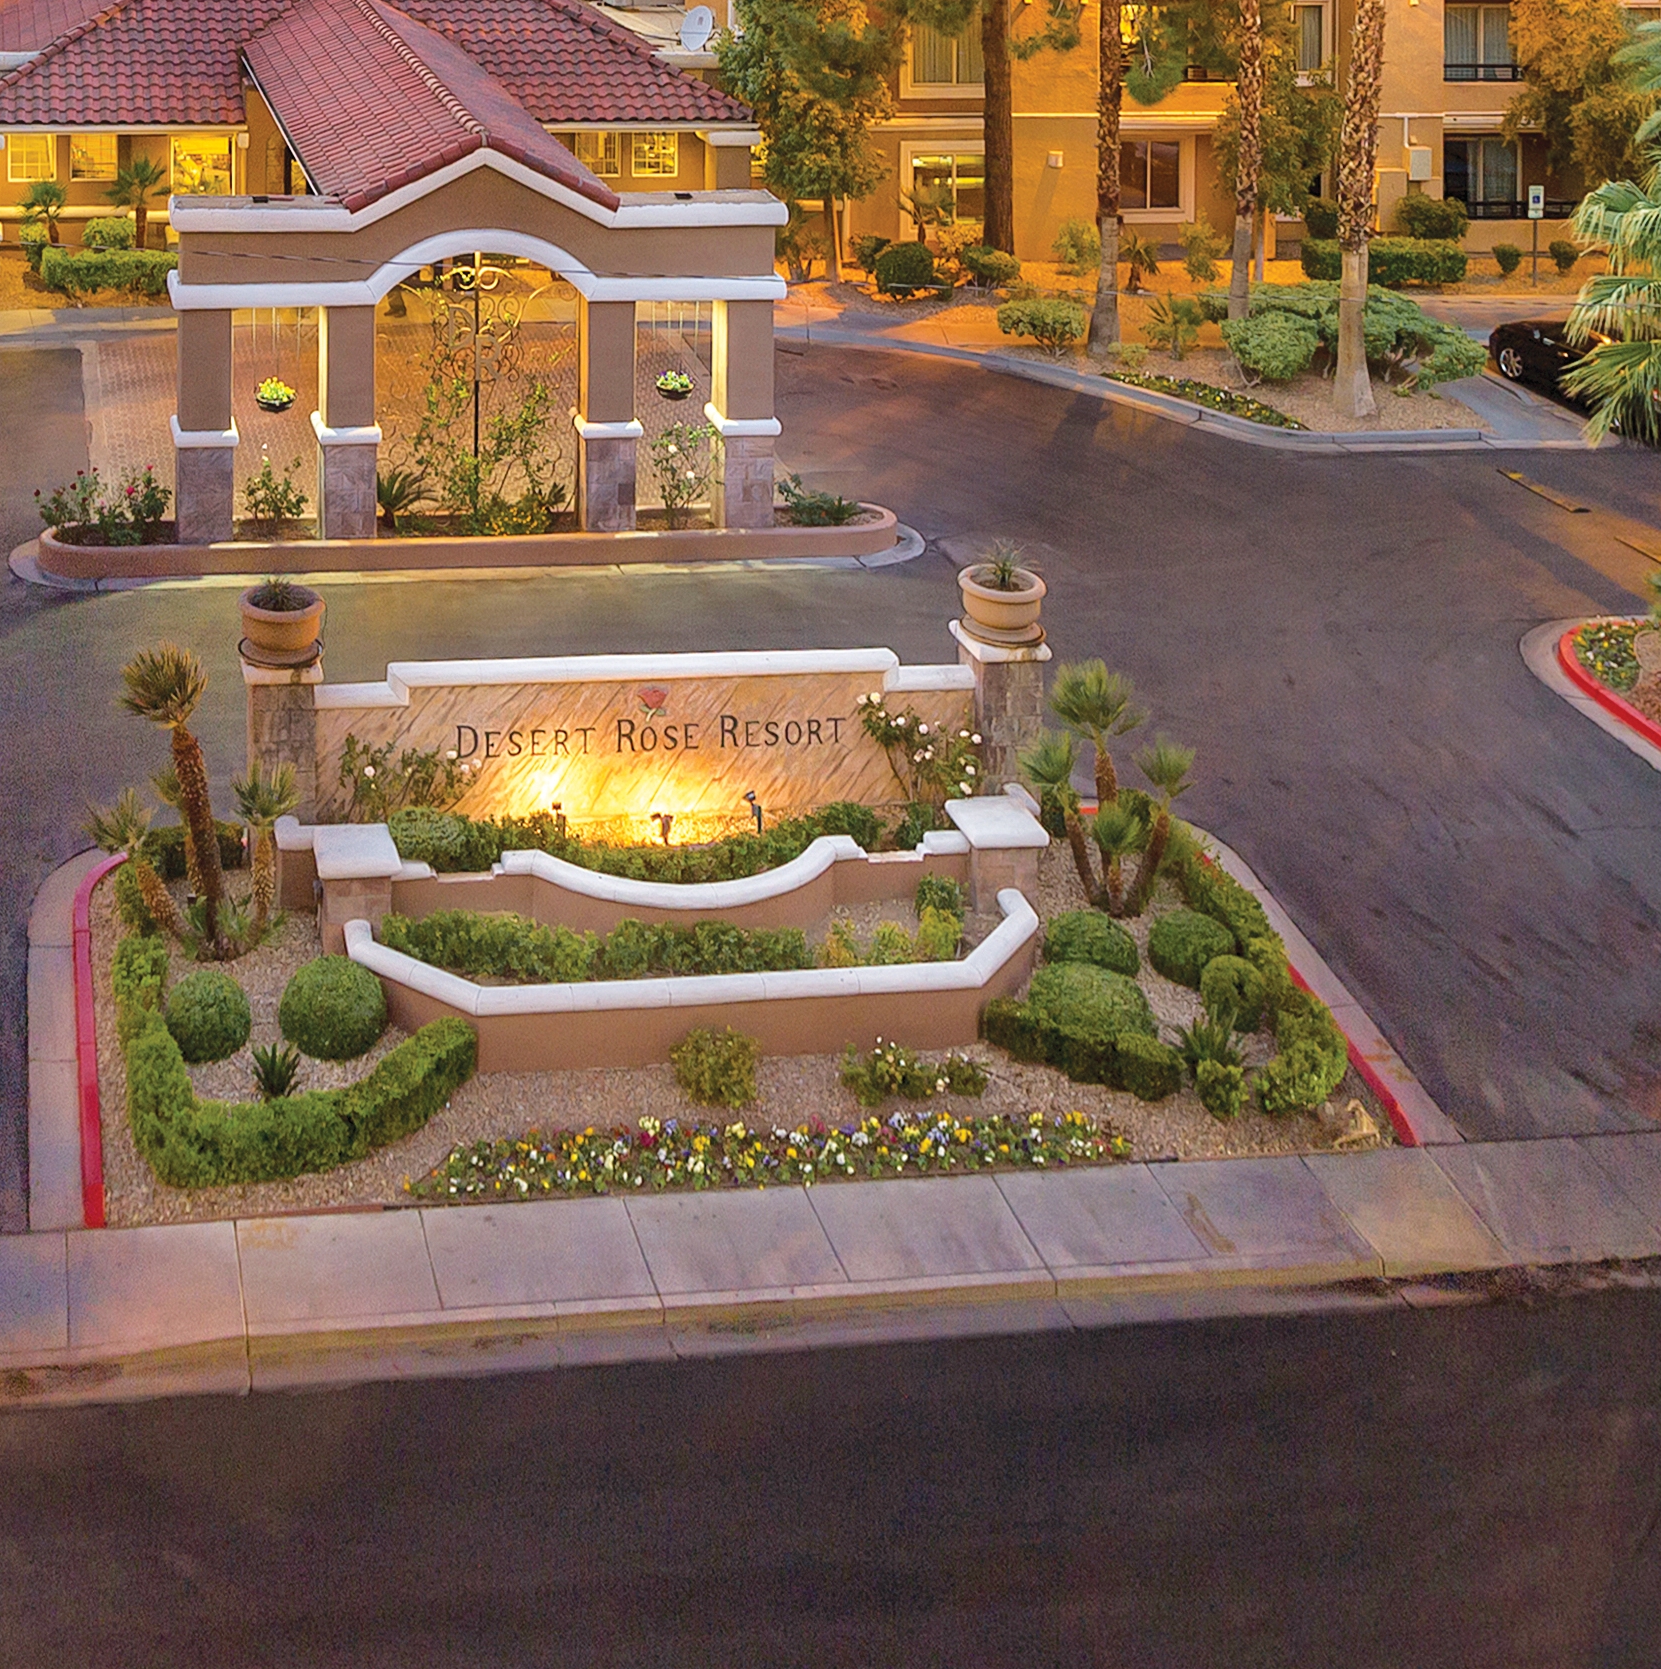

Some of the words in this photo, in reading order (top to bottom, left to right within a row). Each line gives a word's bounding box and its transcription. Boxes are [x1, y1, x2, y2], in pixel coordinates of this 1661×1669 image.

[456, 723, 597, 760] DESERT
[616, 718, 700, 753] ROSE
[720, 714, 846, 750] RESORT
